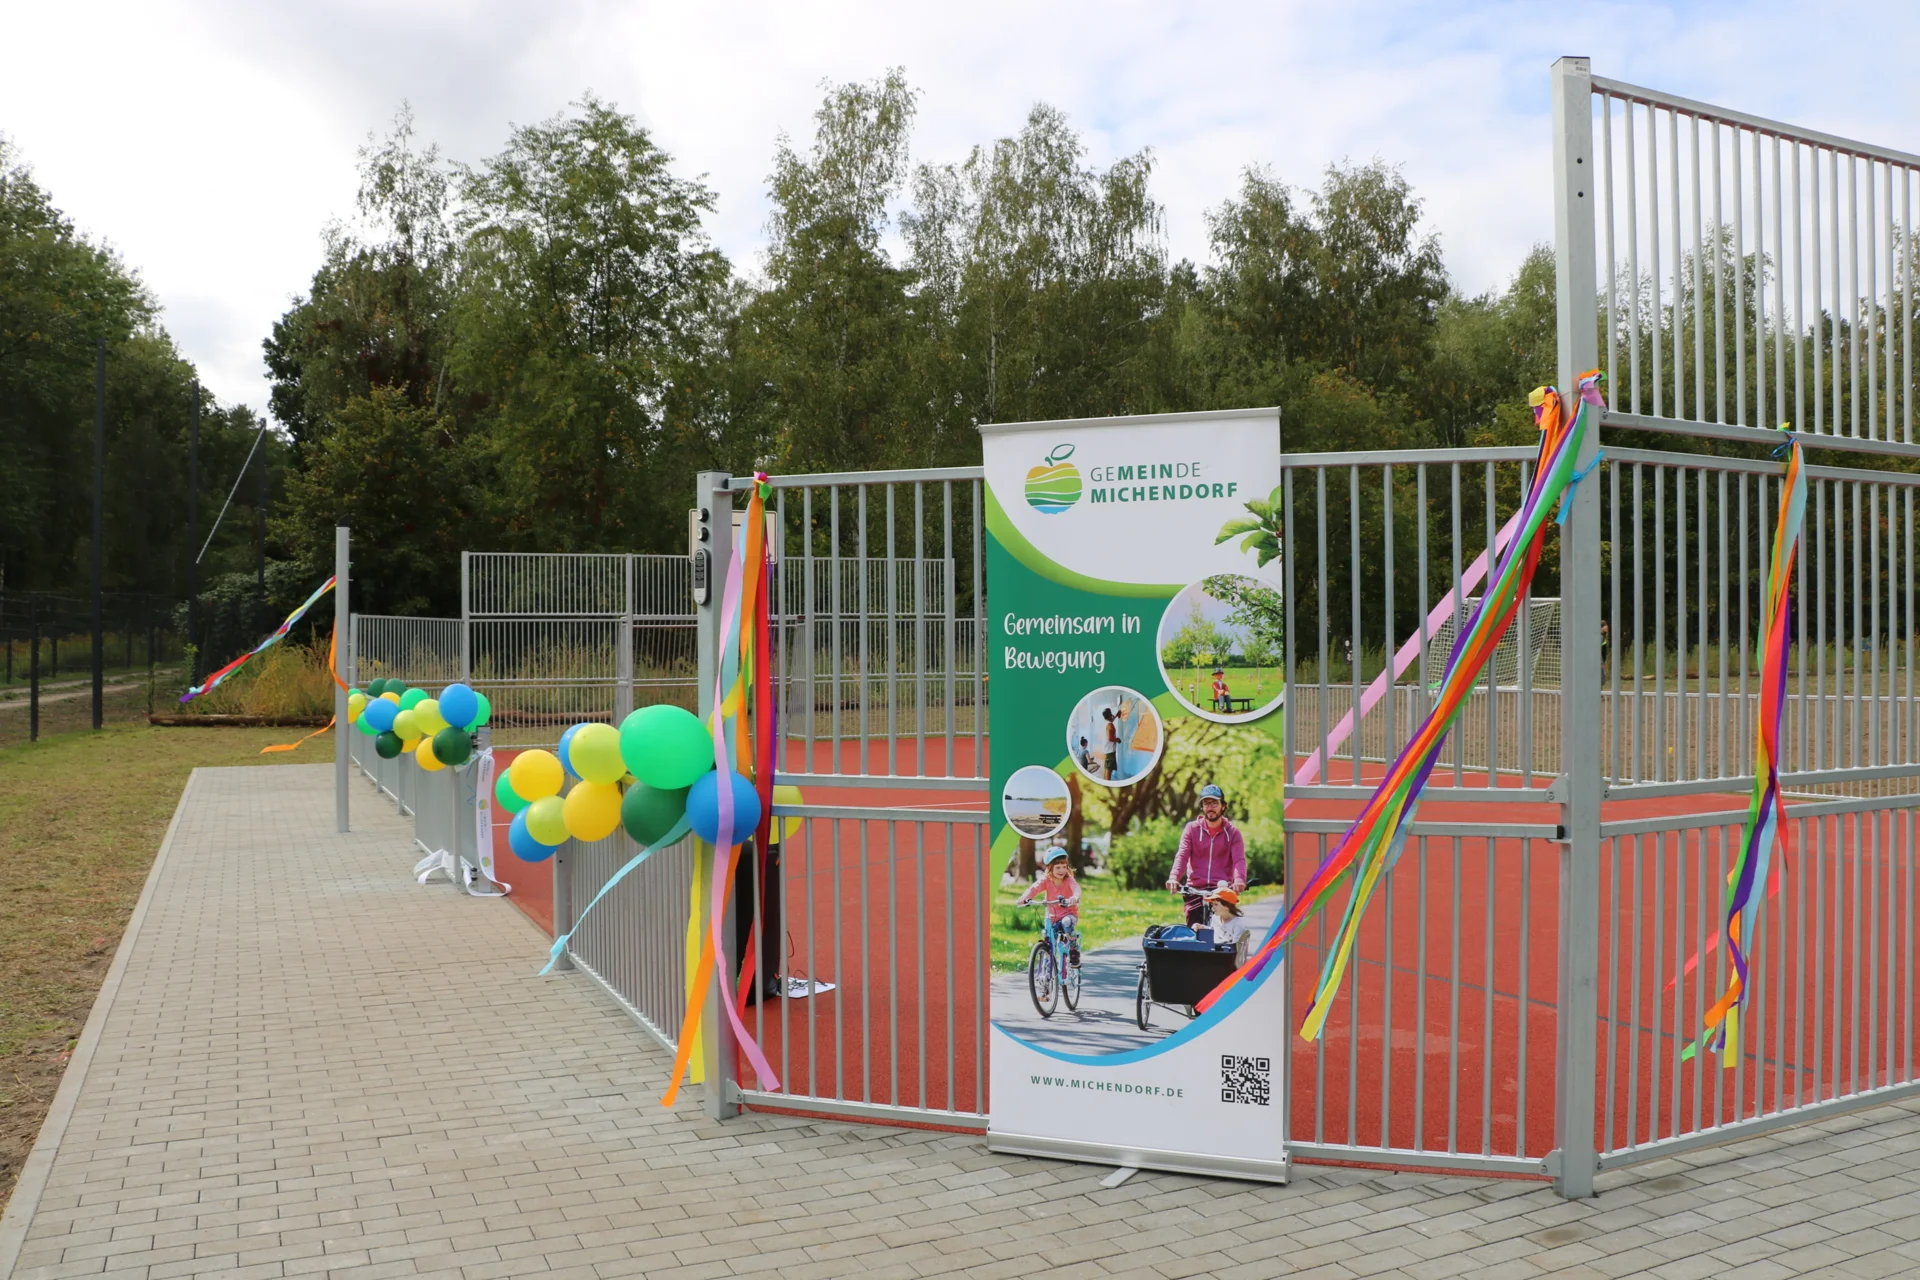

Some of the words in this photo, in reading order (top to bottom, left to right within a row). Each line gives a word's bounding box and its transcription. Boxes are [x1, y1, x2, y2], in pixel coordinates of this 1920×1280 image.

[1090, 462, 1201, 482] GEMEINDE
[1090, 482, 1238, 503] MICHENDORF
[1004, 612, 1115, 635] Gemeinsam
[1122, 613, 1141, 634] in
[1004, 646, 1106, 674] Bewegung
[1030, 1075, 1183, 1097] WWW.MICHENDORF.DE
